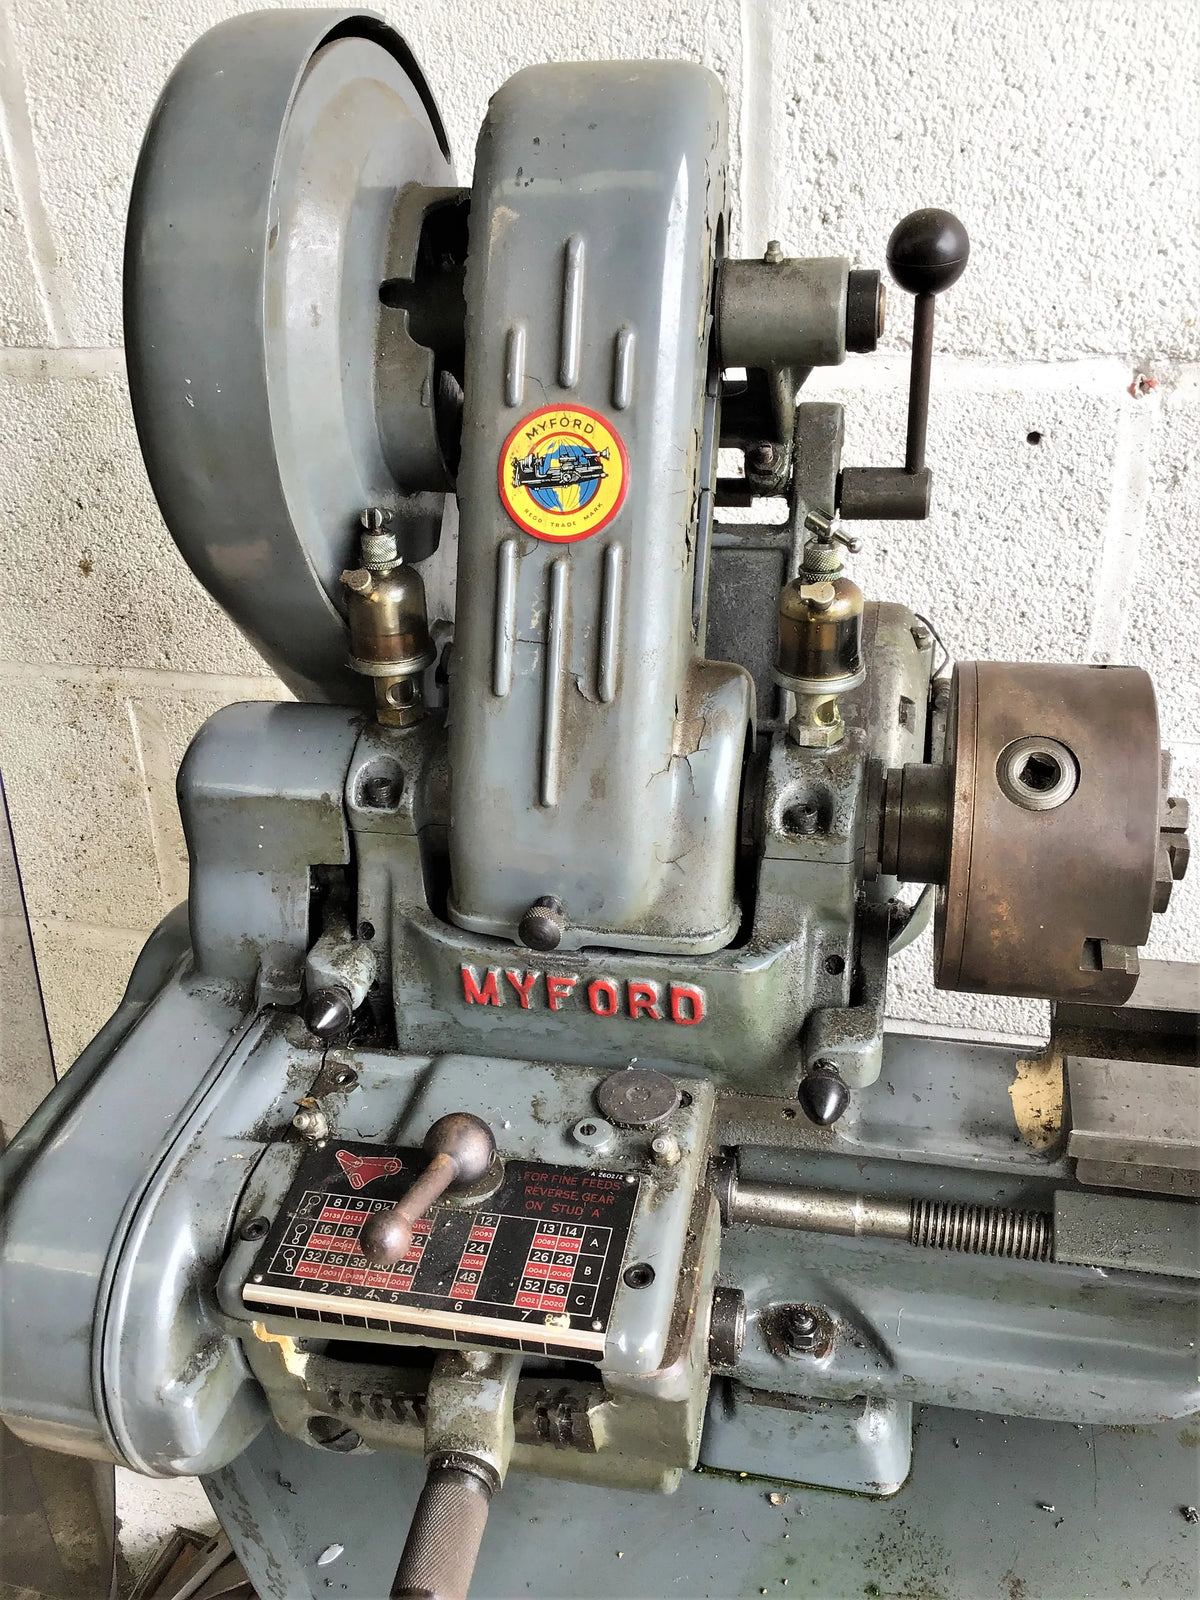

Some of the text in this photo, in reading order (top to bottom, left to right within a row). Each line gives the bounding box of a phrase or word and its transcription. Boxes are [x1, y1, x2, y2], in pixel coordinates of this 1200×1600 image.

[525, 417, 594, 440] MYFORD
[583, 503, 603, 520] MARK
[461, 963, 707, 1025] MYFORD
[523, 1171, 621, 1191] FOR FINE FEEDS
[598, 1172, 623, 1180] 2602/2
[524, 1186, 615, 1204] REVERSE GEAR
[333, 1198, 342, 1207] 8
[355, 1201, 364, 1210] 9
[525, 1200, 544, 1211] ON
[551, 1203, 584, 1216] STUD
[480, 1216, 493, 1226] 12
[320, 1224, 354, 1236] 16 18
[542, 1223, 577, 1236] 13 14
[468, 1243, 485, 1253] 24
[589, 1238, 599, 1247] A
[305, 1251, 322, 1261] 32
[327, 1254, 344, 1264] 36
[350, 1257, 368, 1267] 38
[396, 1263, 413, 1273] 44
[532, 1251, 573, 1265] 26 28
[459, 1271, 477, 1282] 48
[584, 1266, 592, 1275] B
[524, 1280, 565, 1294] 52 56
[299, 1279, 305, 1289] 1
[320, 1282, 329, 1292] 2
[343, 1286, 352, 1295] 3
[364, 1289, 375, 1299] 4
[389, 1292, 399, 1302] 5
[454, 1301, 464, 1311] 6
[521, 1310, 532, 1321] 7
[575, 1295, 586, 1305] C
